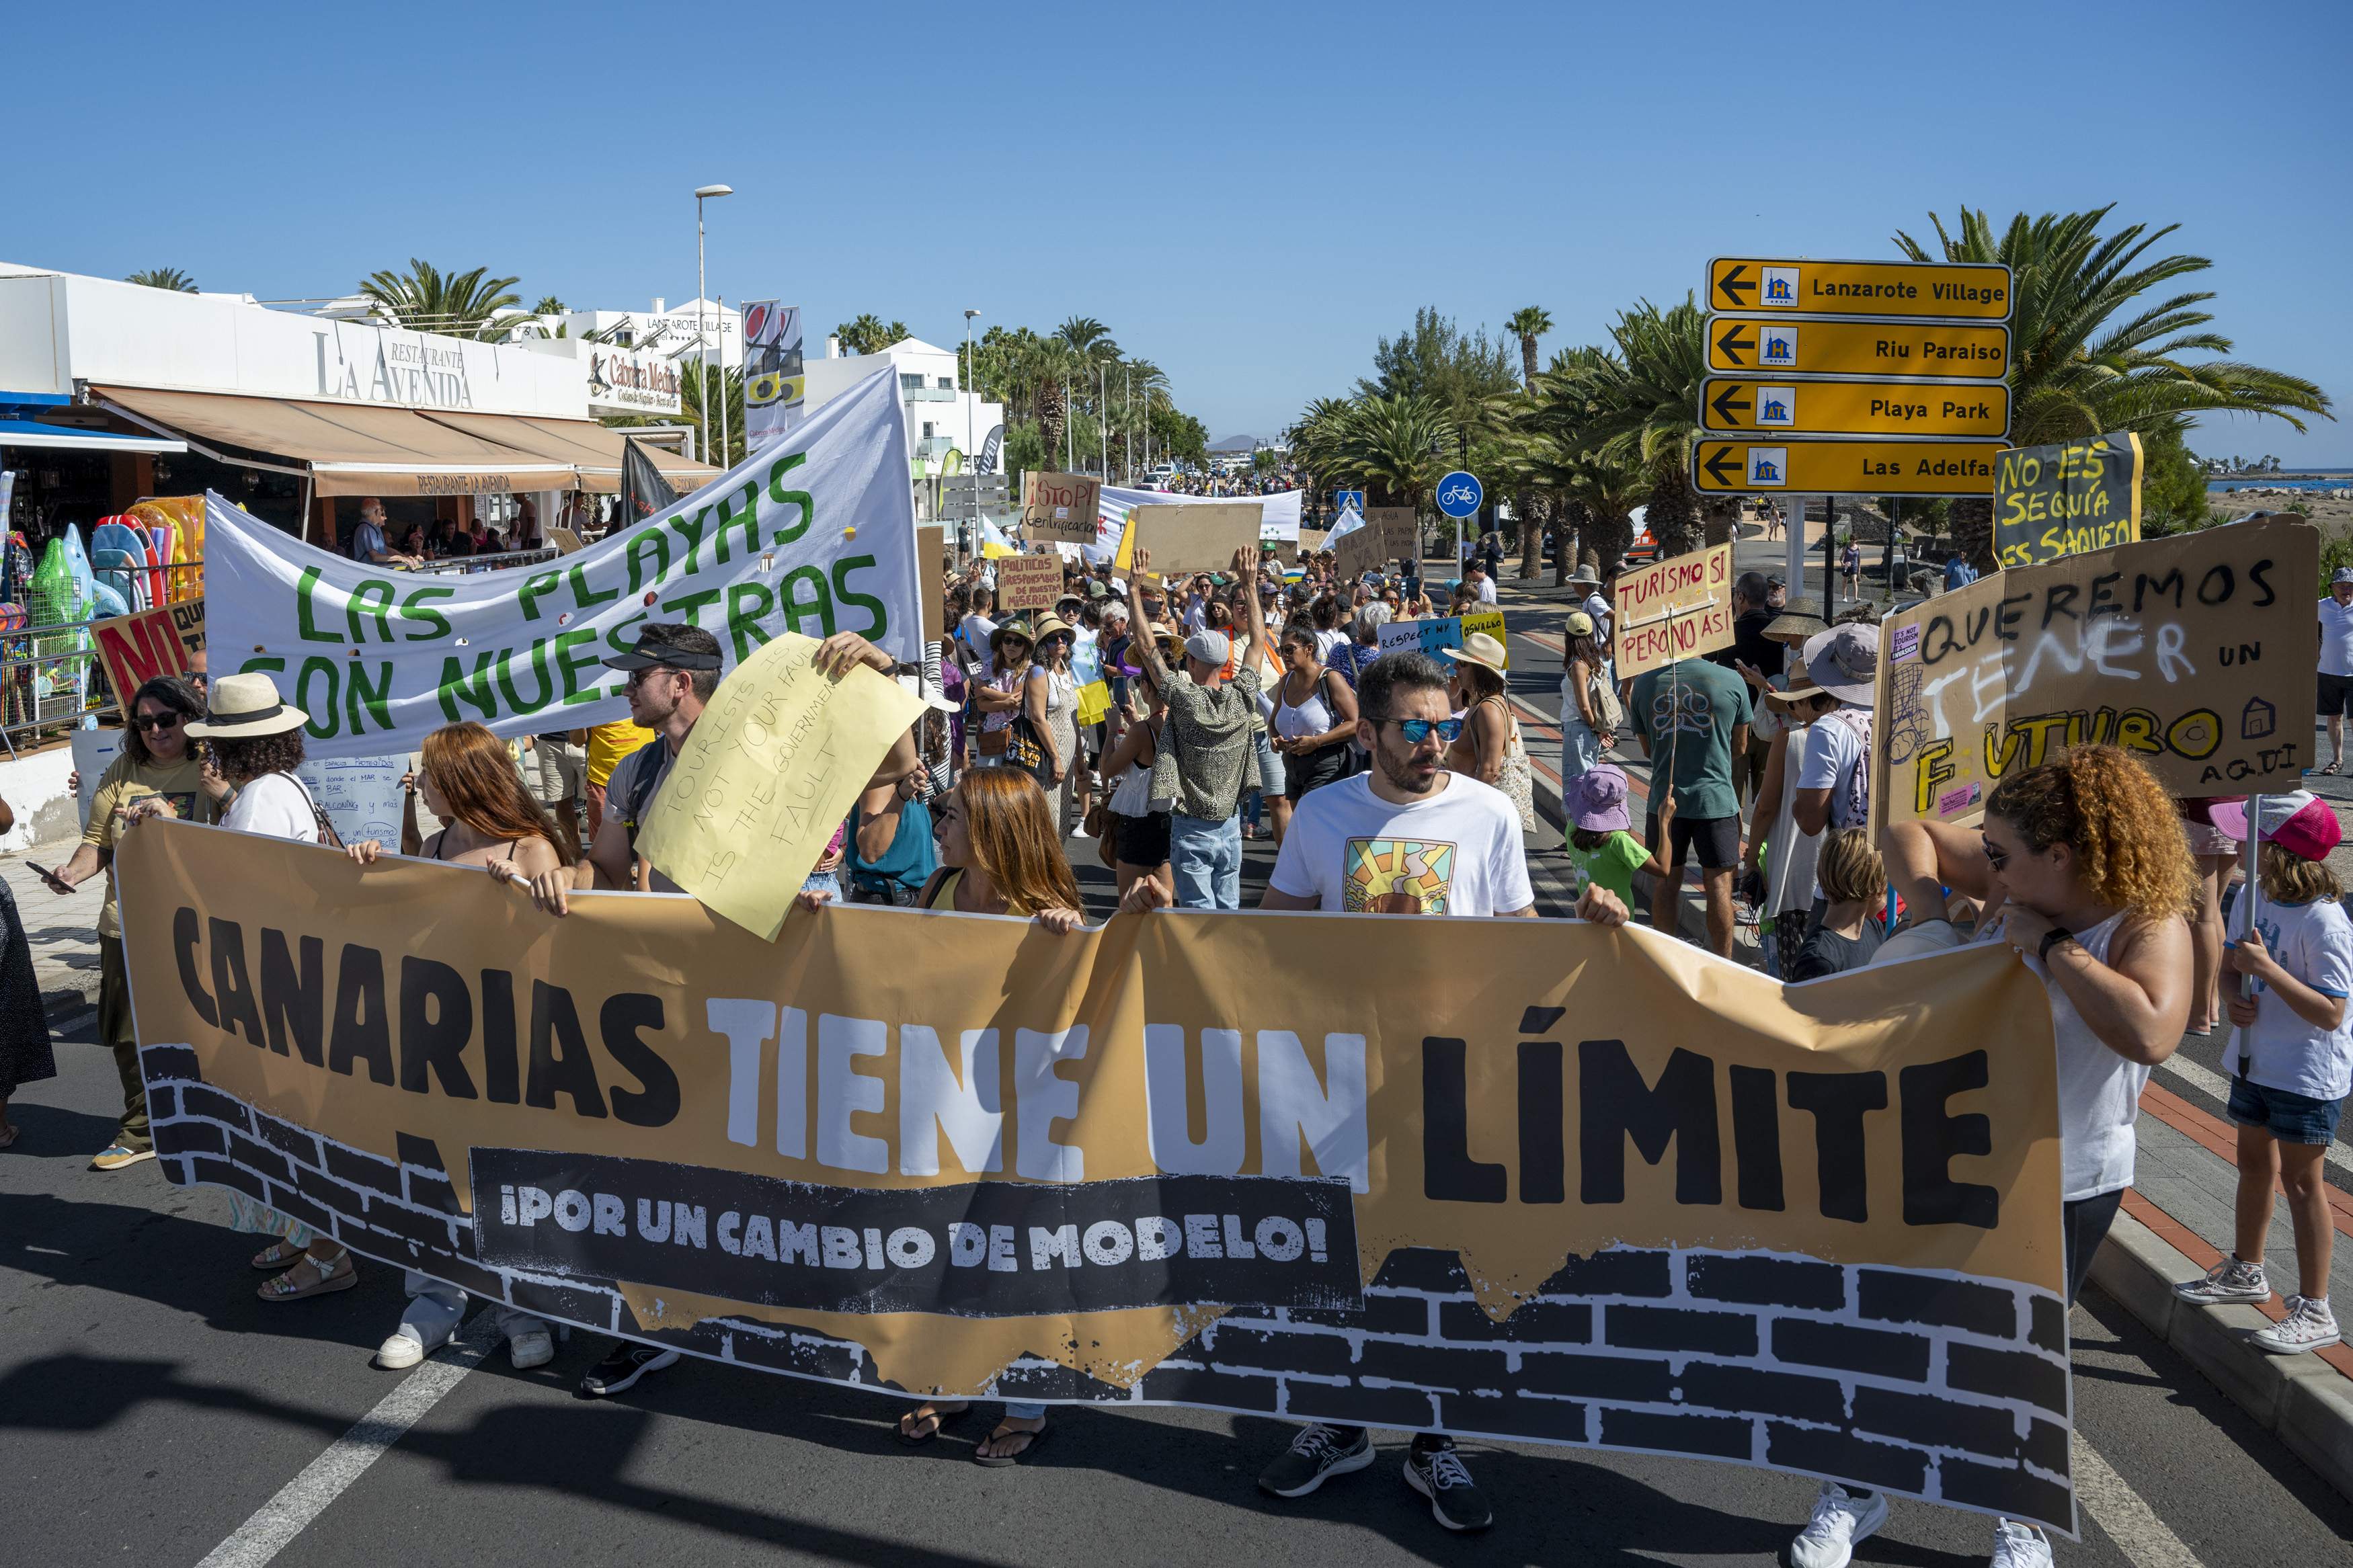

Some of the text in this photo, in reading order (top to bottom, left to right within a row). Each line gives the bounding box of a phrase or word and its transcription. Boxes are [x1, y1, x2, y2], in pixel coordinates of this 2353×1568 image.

[1813, 279, 1917, 300] Lanzarote
[1931, 283, 2005, 304] Village
[391, 343, 464, 369] RESTAURANTE
[1876, 340, 1909, 358] Riu
[1923, 341, 2001, 361] Paraiso
[369, 339, 474, 409] AVENIDA
[610, 354, 681, 395] Cabrera Medina
[1767, 399, 1990, 421] AT Playa Park
[417, 474, 512, 495] RESTAURANTE LA AVENIDA
[1759, 466, 1776, 479] AT
[1862, 458, 1901, 476] Las
[2000, 441, 2110, 495] NO ES
[2001, 480, 2110, 526] SEQUÍA
[297, 452, 813, 644] LAS PLAYAS
[2002, 542, 2033, 565] ES
[1015, 584, 1062, 595] DE NUESTRA
[1907, 626, 1916, 634] NOT
[1921, 559, 2275, 665] QUEREMOS
[1382, 623, 1450, 649] RESPECT MY
[1622, 628, 1667, 663] PERO
[1672, 618, 1696, 651] NO
[1892, 645, 1917, 659] INVASION
[1894, 632, 1918, 645] TOURISM
[1921, 622, 2262, 739] TENER UN
[663, 646, 791, 818] TOURISTS IS
[693, 766, 731, 833] NOT
[727, 690, 788, 758] YOUR
[1915, 706, 2223, 813] FUTURO
[769, 731, 836, 846] FAULT
[366, 827, 394, 835] turismo
[701, 850, 736, 891] IS
[728, 782, 776, 833] THE
[173, 906, 1999, 1229] CANARIAS TIENE UN LÍMITE
[500, 1183, 1327, 1272] ¡POR UN CAMBIO DE MODELO!
